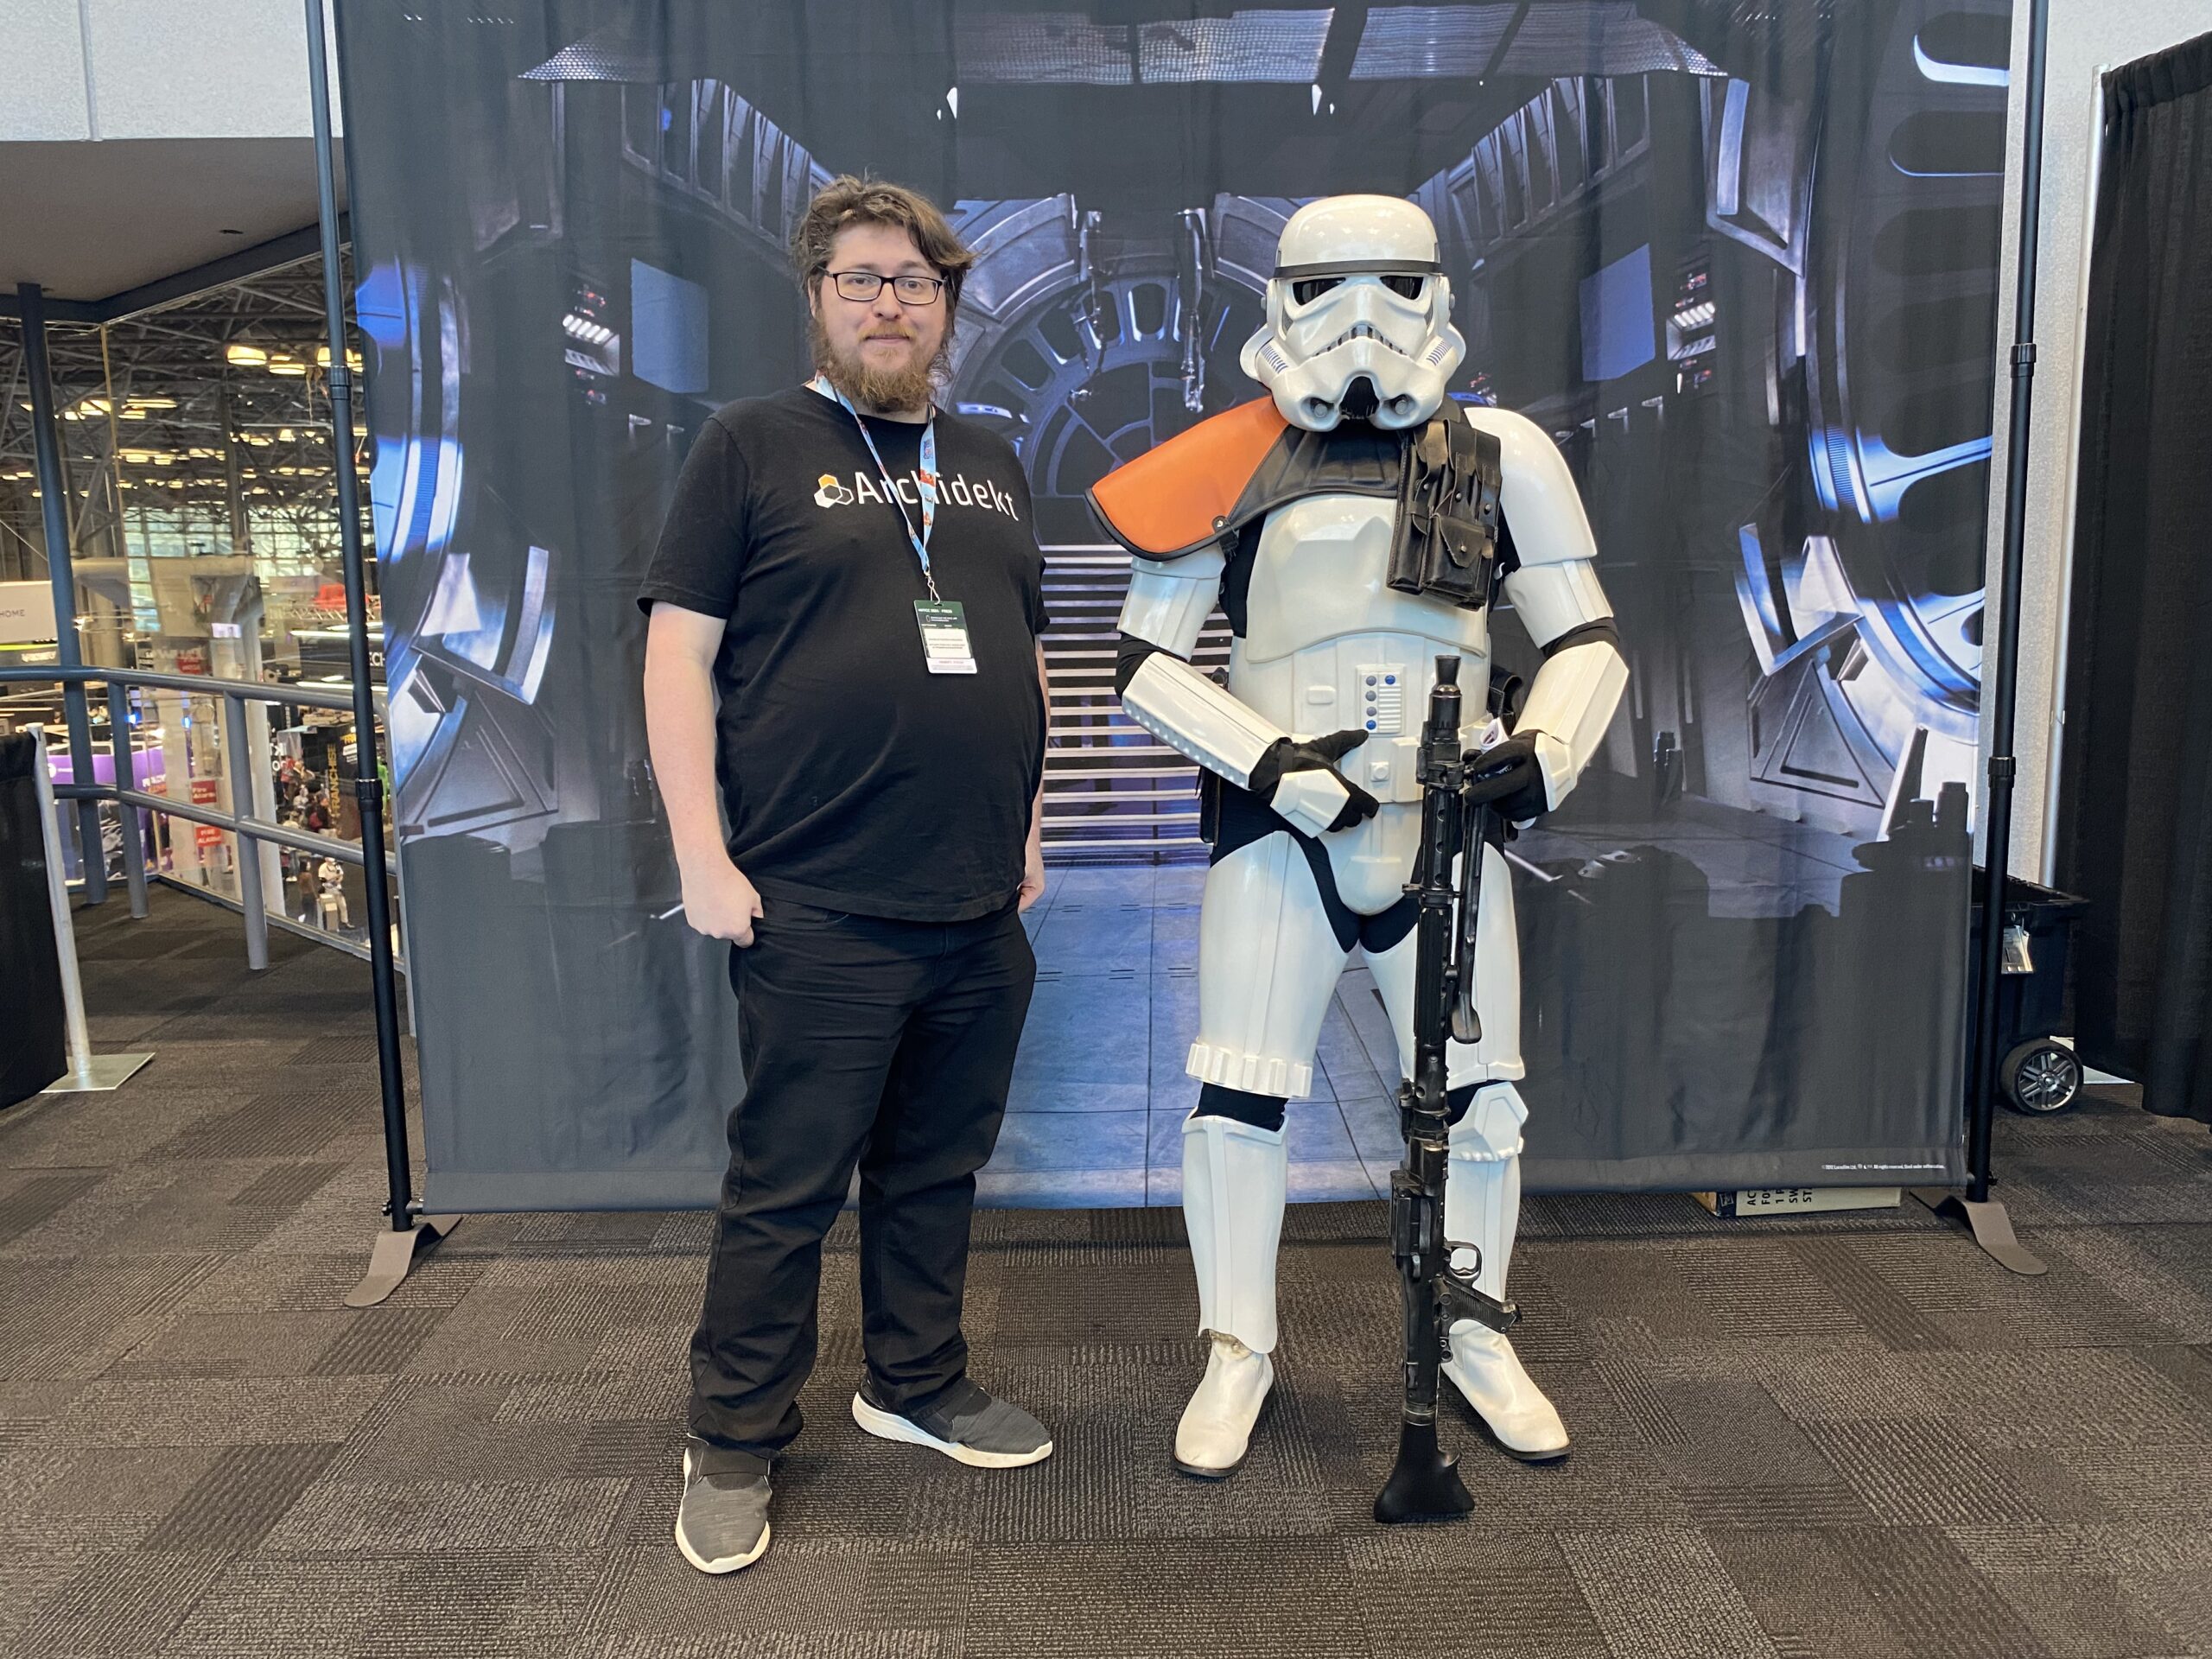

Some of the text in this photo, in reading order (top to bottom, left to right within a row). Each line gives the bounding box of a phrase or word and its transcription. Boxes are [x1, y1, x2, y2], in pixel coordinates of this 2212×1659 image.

[1747, 1190, 1757, 1205] AC
[1762, 1190, 1770, 1205] FO
[1803, 1188, 1813, 1202] ST
